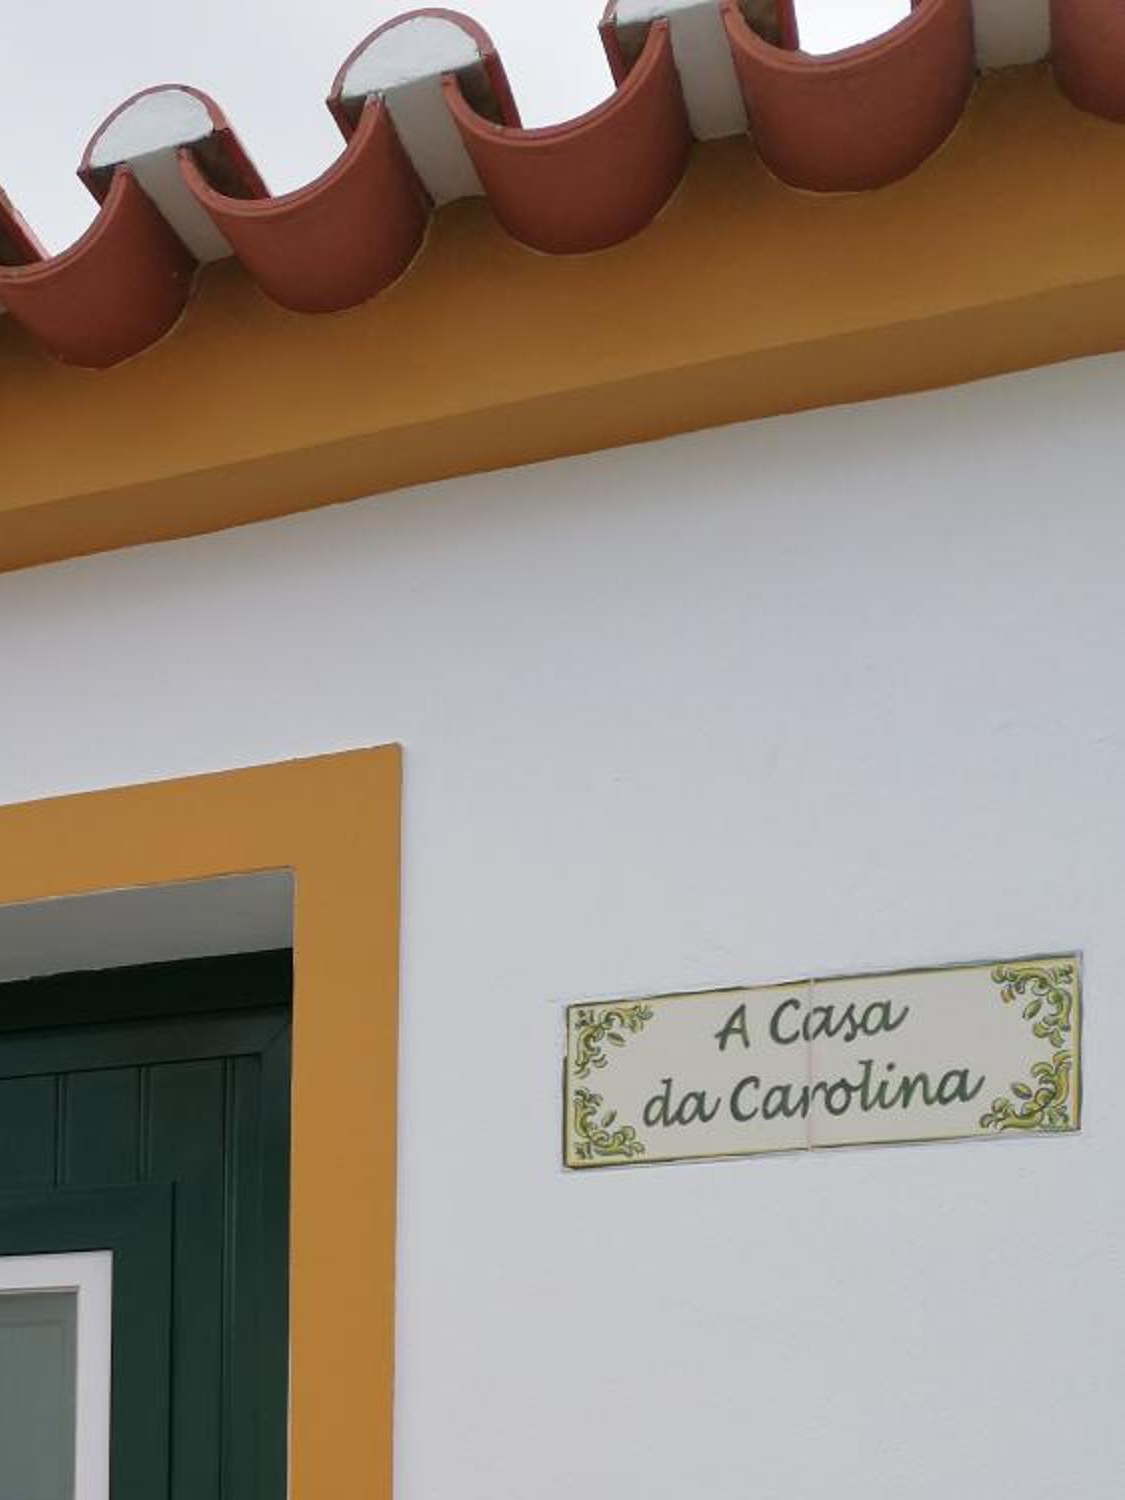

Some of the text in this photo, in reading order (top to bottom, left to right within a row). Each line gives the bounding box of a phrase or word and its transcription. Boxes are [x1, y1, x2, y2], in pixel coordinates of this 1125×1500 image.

[714, 998, 910, 1051] A Casa
[642, 1059, 986, 1129] da Carolina
